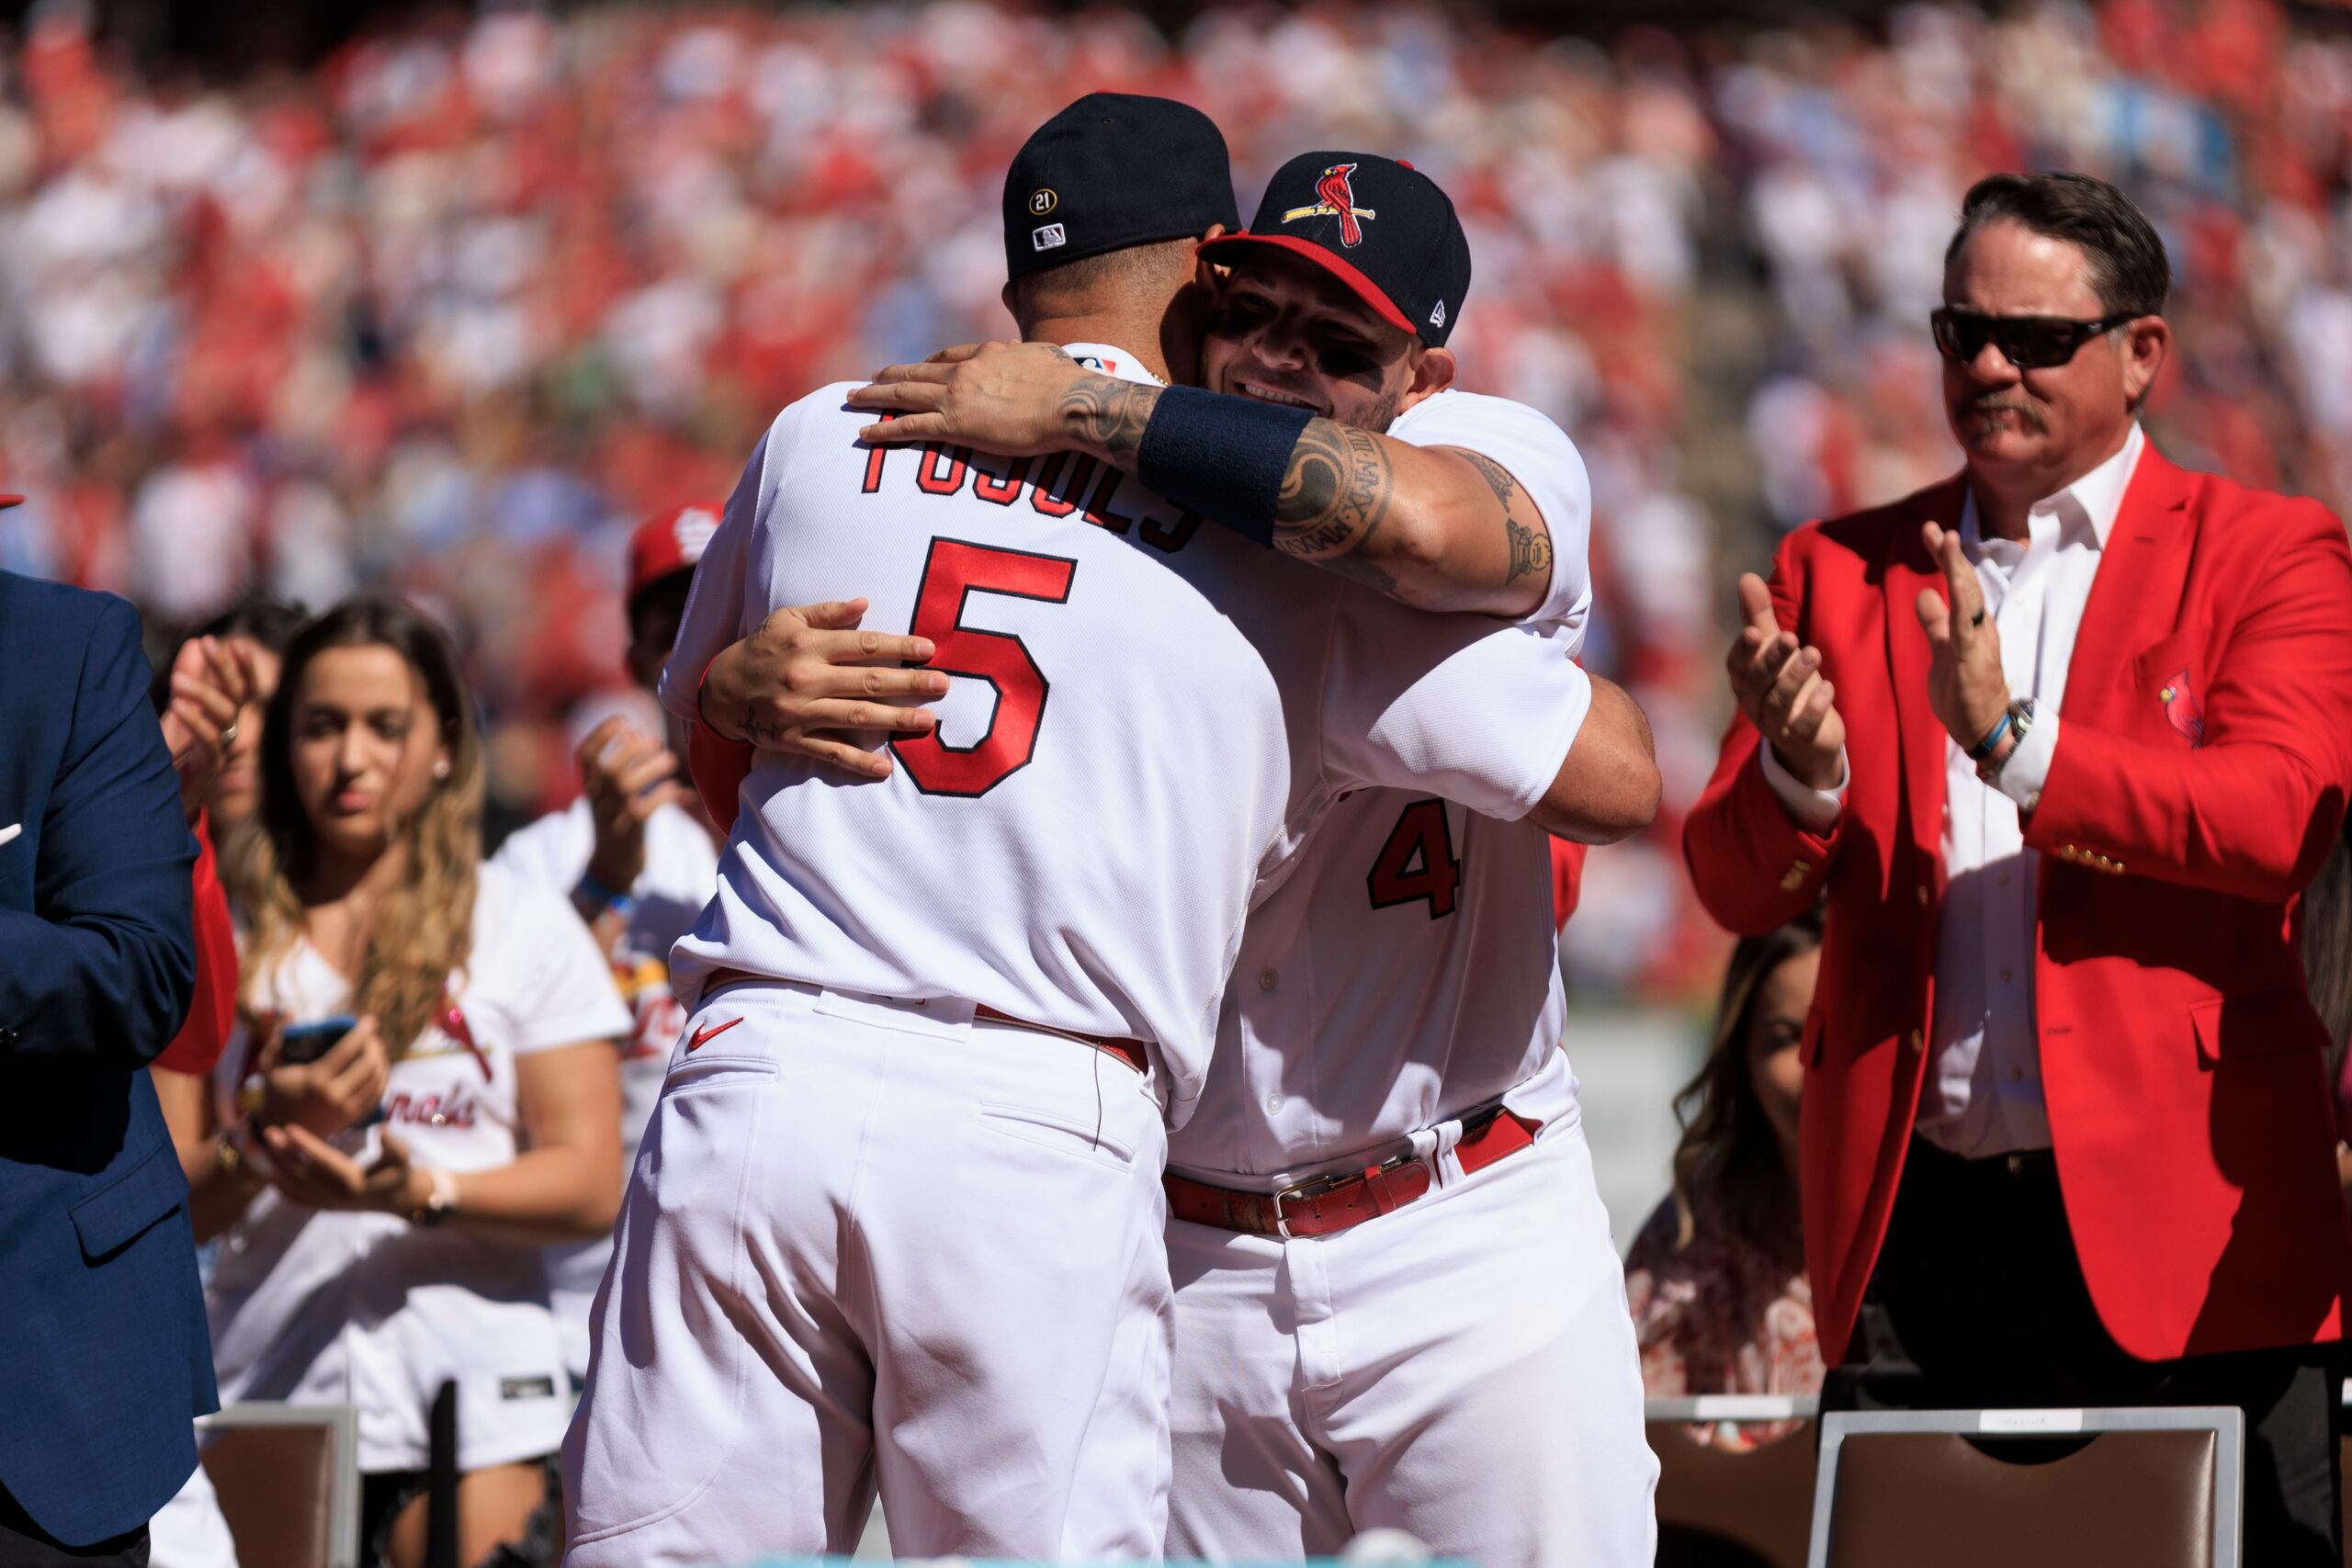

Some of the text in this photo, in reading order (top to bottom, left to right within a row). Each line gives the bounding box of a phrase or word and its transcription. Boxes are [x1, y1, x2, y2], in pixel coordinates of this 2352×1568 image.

[1035, 191, 1050, 211] 21
[888, 536, 1079, 798] 5
[1366, 797, 1460, 920] 4
